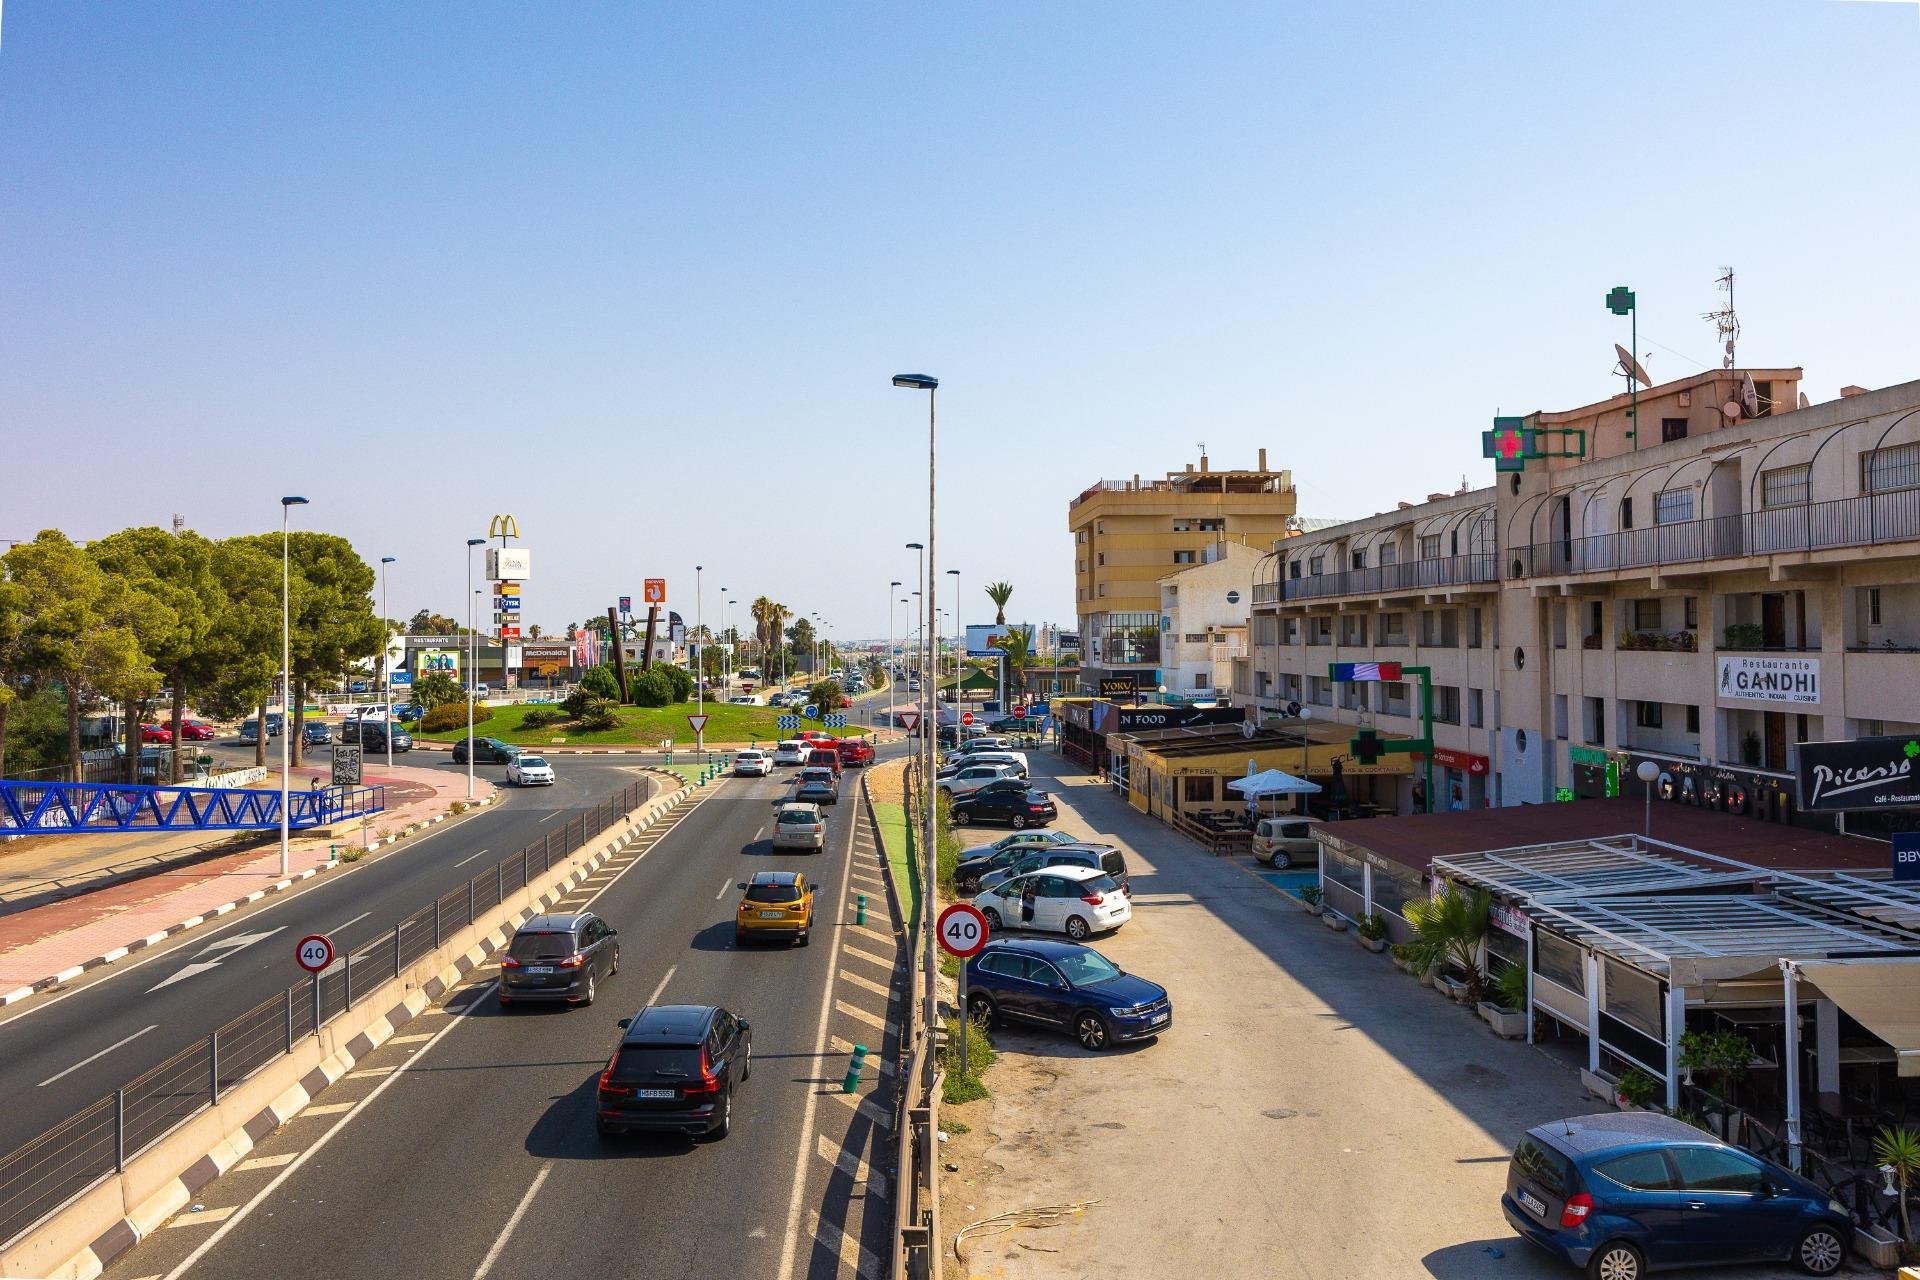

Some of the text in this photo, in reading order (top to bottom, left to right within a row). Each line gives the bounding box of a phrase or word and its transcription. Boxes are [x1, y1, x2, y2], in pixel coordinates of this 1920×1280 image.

[1742, 659, 1810, 670] Restaurante
[1103, 681, 1132, 691] YOKU
[1736, 671, 1816, 693] GANDHI
[1735, 691, 1765, 699] AUTHENTIC
[1793, 694, 1817, 702] CUISINE
[1135, 715, 1166, 724] FOOD
[1811, 758, 1911, 806] Picasso
[1874, 794, 1887, 803] Café
[947, 922, 977, 940] 40
[303, 947, 325, 960] 40
